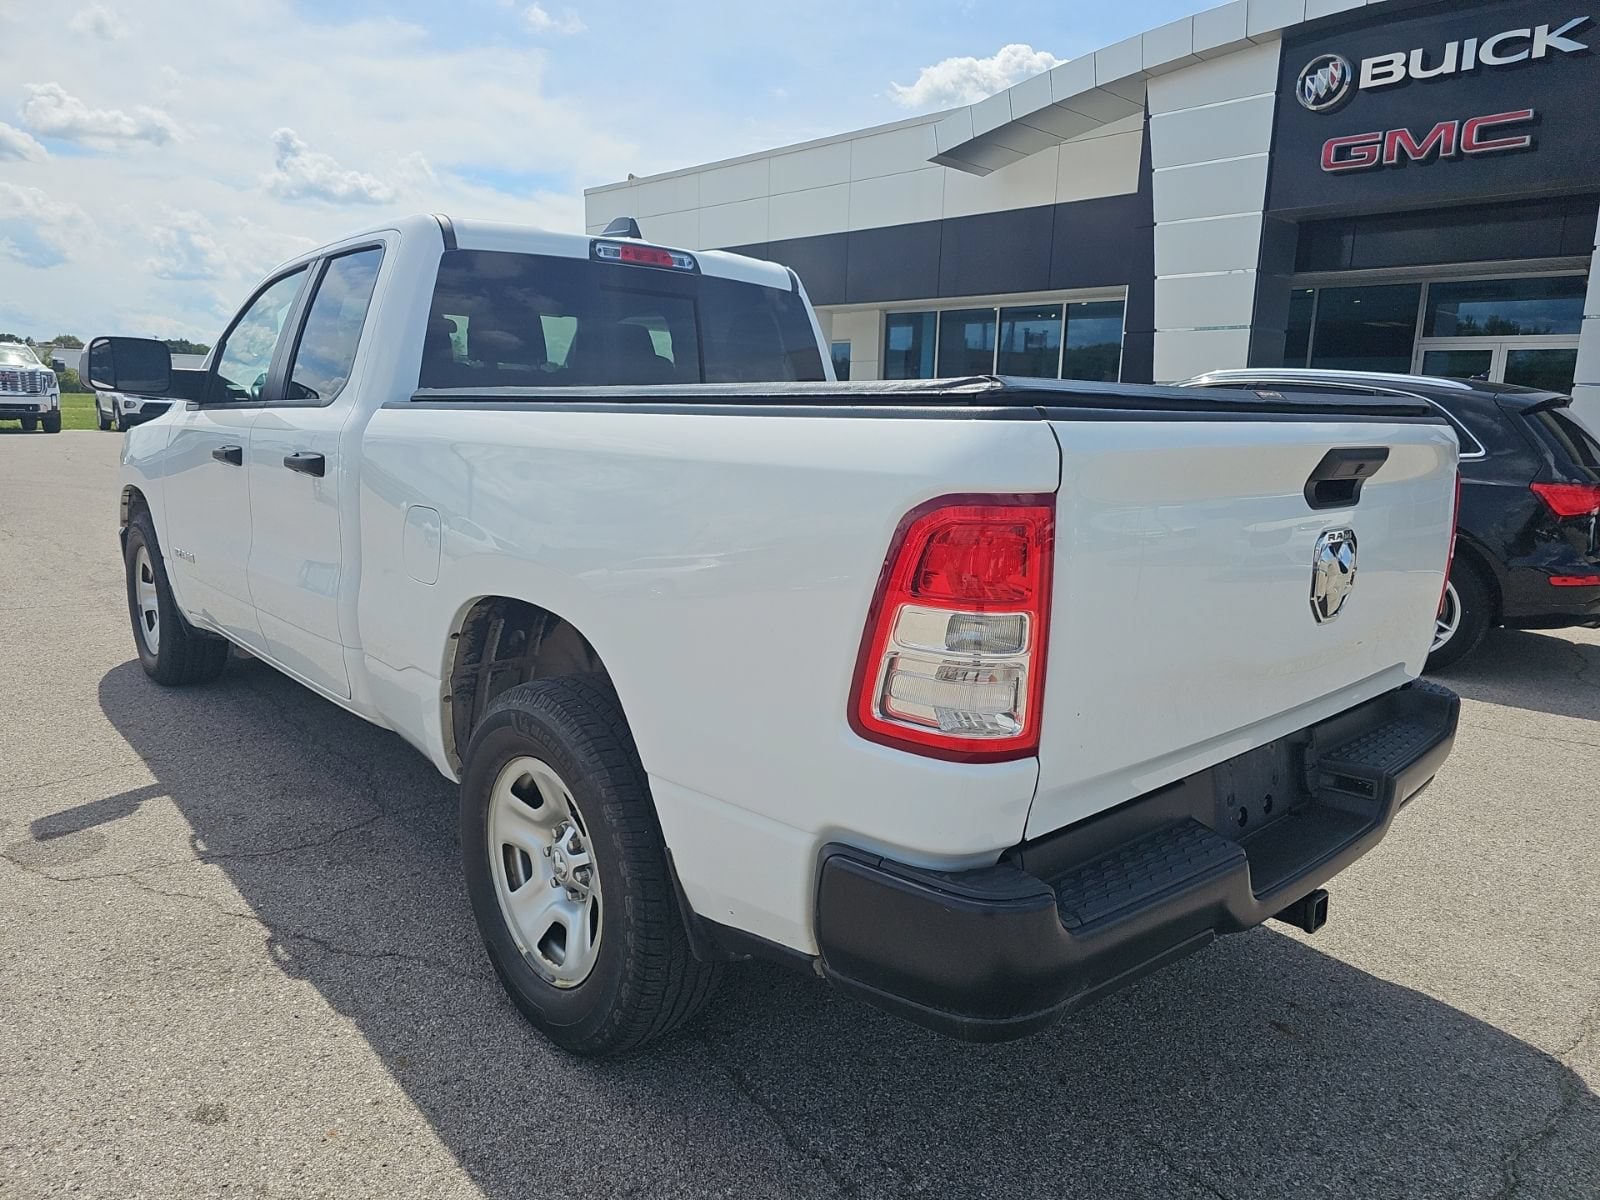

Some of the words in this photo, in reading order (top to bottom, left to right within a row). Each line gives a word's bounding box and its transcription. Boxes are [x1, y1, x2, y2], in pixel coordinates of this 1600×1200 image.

[1358, 16, 1590, 90] BUICK
[1320, 108, 1534, 172] GMC
[1327, 531, 1352, 542] RAM
